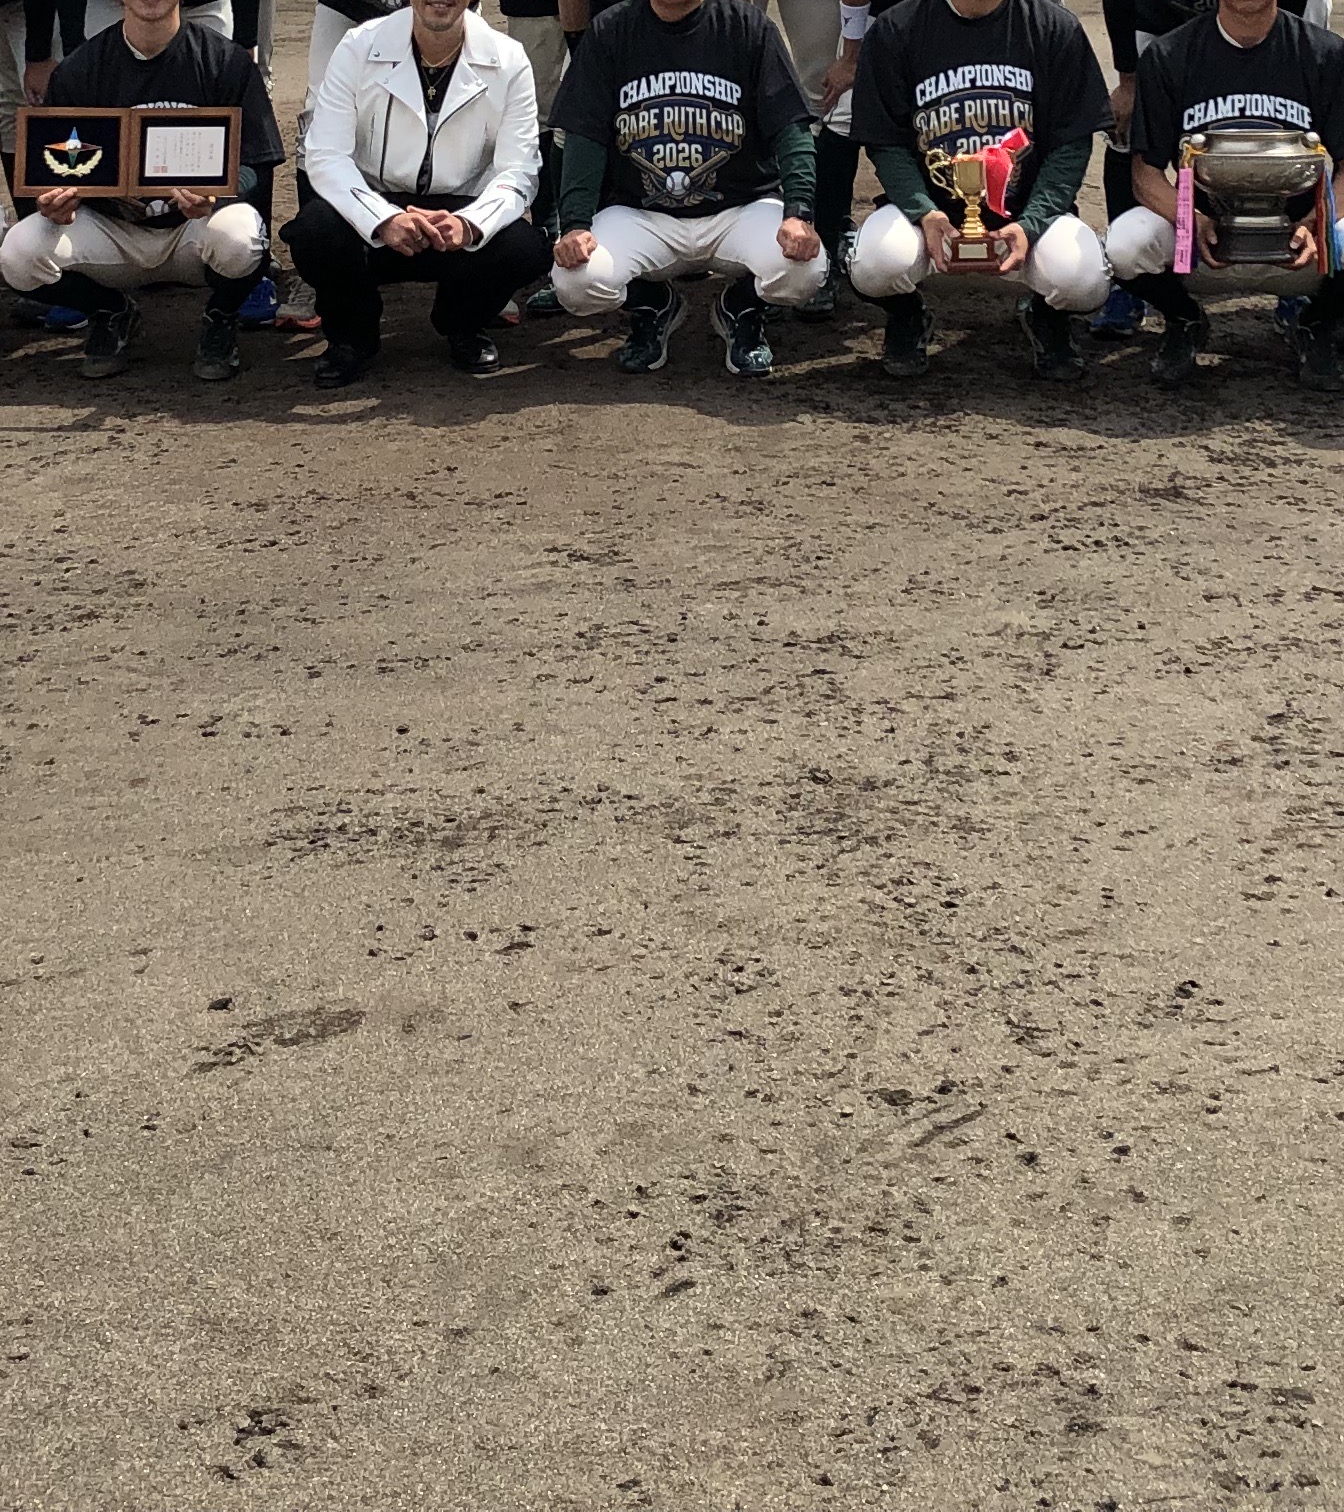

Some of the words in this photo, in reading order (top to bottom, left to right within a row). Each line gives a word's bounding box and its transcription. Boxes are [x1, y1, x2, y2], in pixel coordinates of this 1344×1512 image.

[619, 71, 742, 109] CHAMPIONSHIP
[915, 64, 1033, 107] CHAMPIONSHI
[617, 109, 659, 149] BABE
[662, 106, 707, 140] RUTH
[710, 111, 744, 147] CUP
[916, 103, 962, 149] BABE
[965, 99, 1010, 135] RUTH
[1013, 103, 1034, 131] CU
[652, 143, 704, 169] 2026
